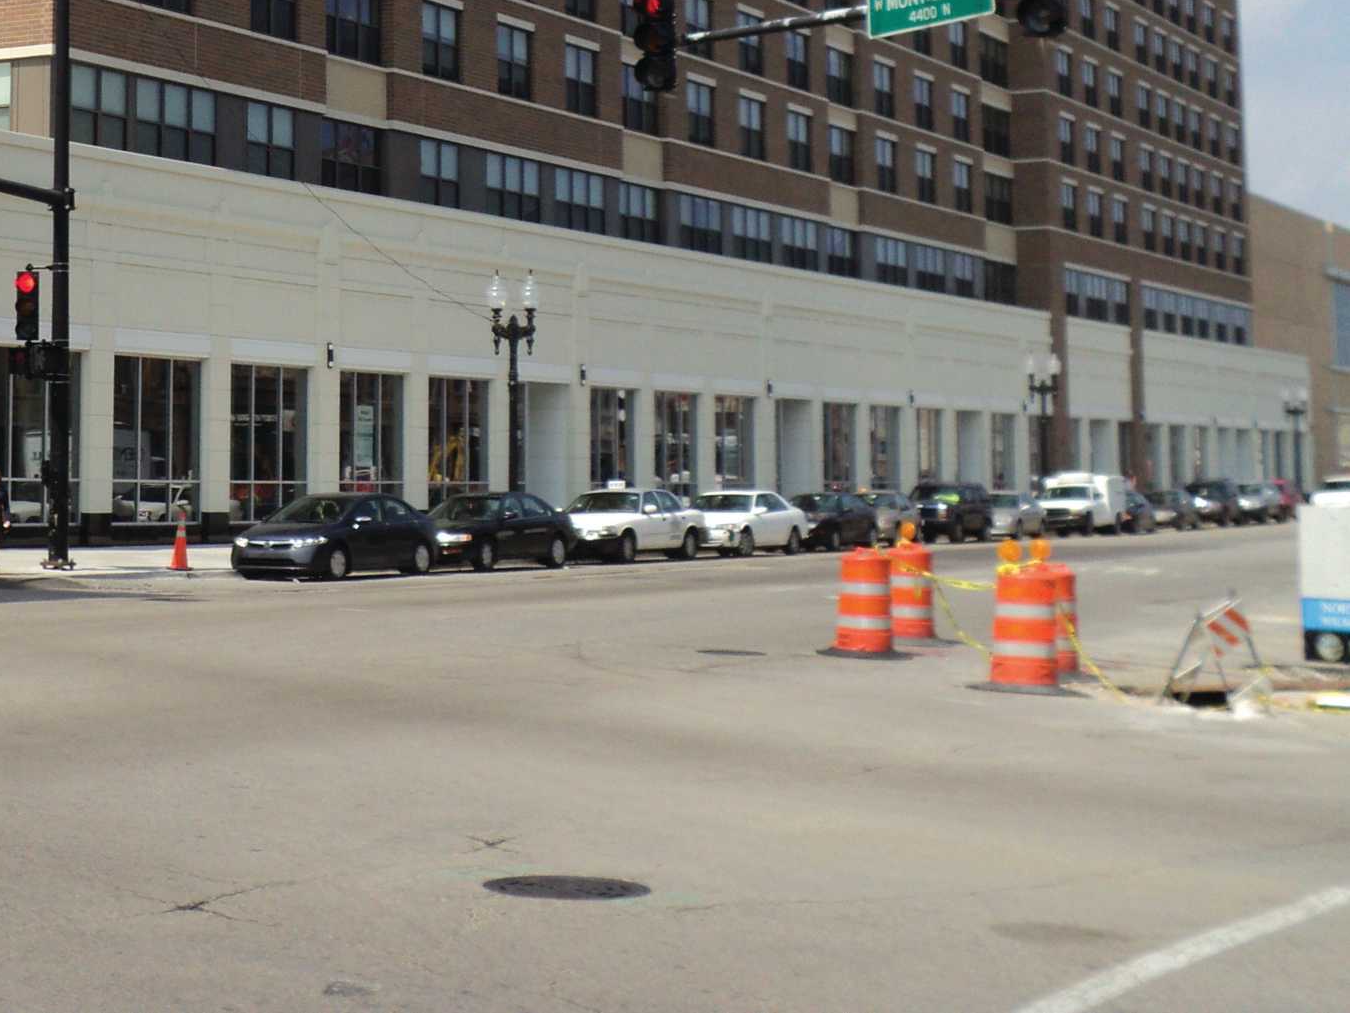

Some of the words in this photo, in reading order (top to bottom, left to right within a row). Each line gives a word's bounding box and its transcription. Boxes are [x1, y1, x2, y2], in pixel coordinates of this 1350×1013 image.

[874, 0, 883, 12] W
[908, 6, 938, 23] 4400
[942, 3, 951, 15] N
